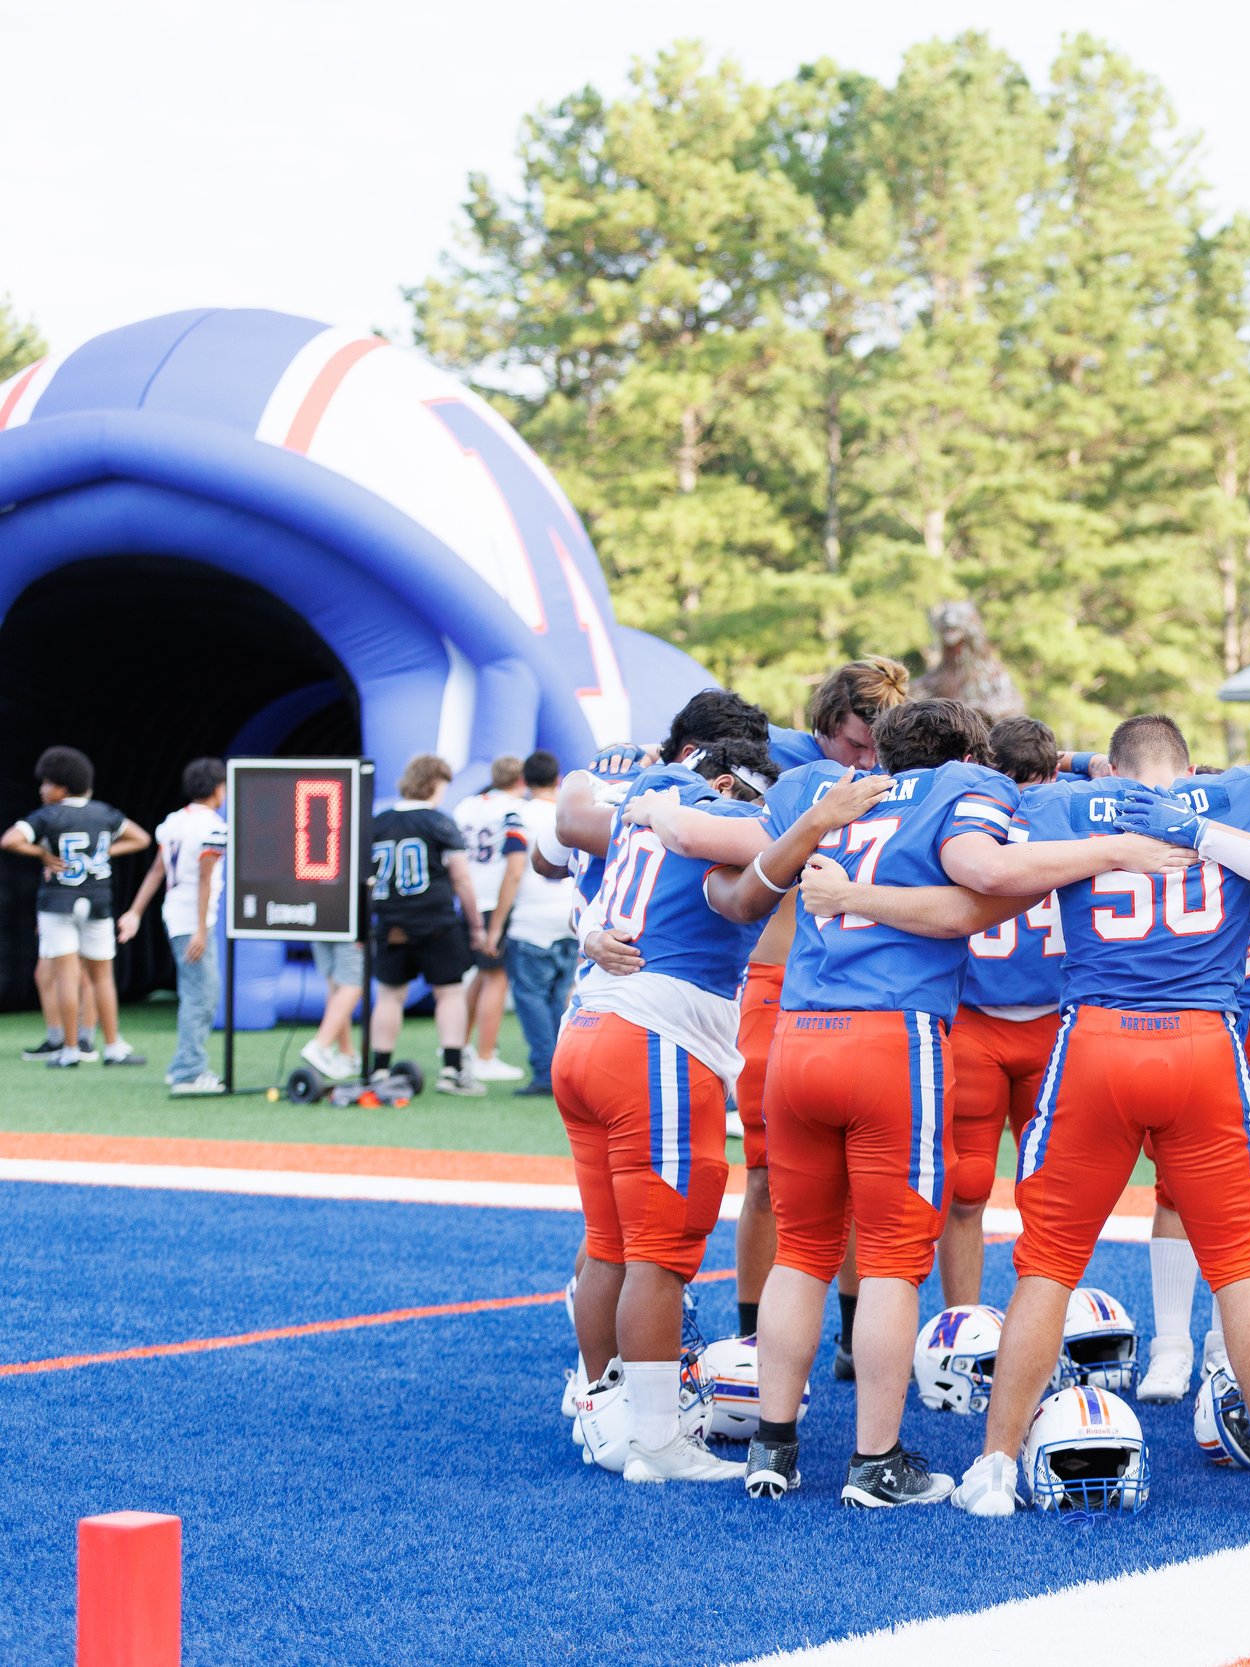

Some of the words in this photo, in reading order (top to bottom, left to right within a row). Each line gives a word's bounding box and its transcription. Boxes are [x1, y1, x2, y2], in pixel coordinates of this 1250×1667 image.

[295, 780, 342, 880] 0
[58, 831, 112, 887] 54
[371, 837, 431, 900] 70
[1091, 834, 1225, 942] 50
[795, 1015, 852, 1030] NORTHWEST
[1120, 1015, 1181, 1031] NORTHWEST
[928, 1312, 972, 1349] N
